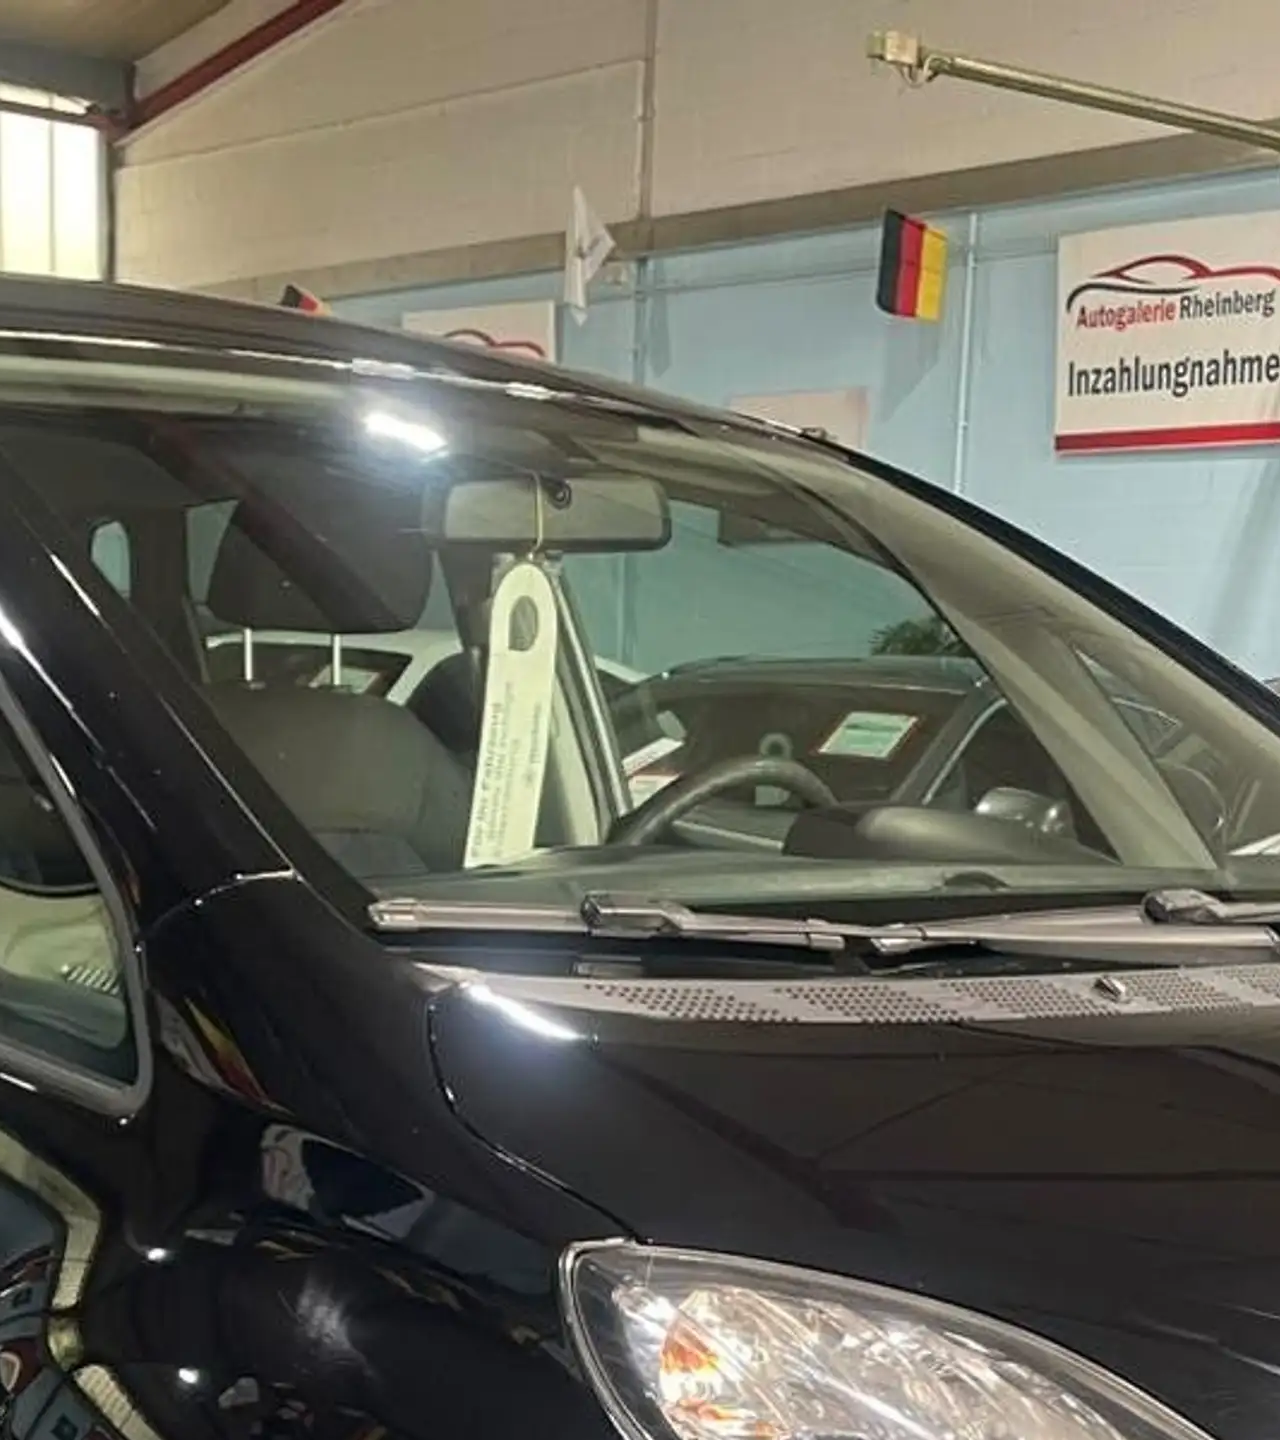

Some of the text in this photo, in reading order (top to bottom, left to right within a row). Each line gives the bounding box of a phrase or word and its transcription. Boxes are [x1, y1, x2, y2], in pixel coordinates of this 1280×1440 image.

[1076, 288, 1277, 333] Autogalerie Rheinberg
[1067, 349, 1280, 399] Inzahlungnahme
